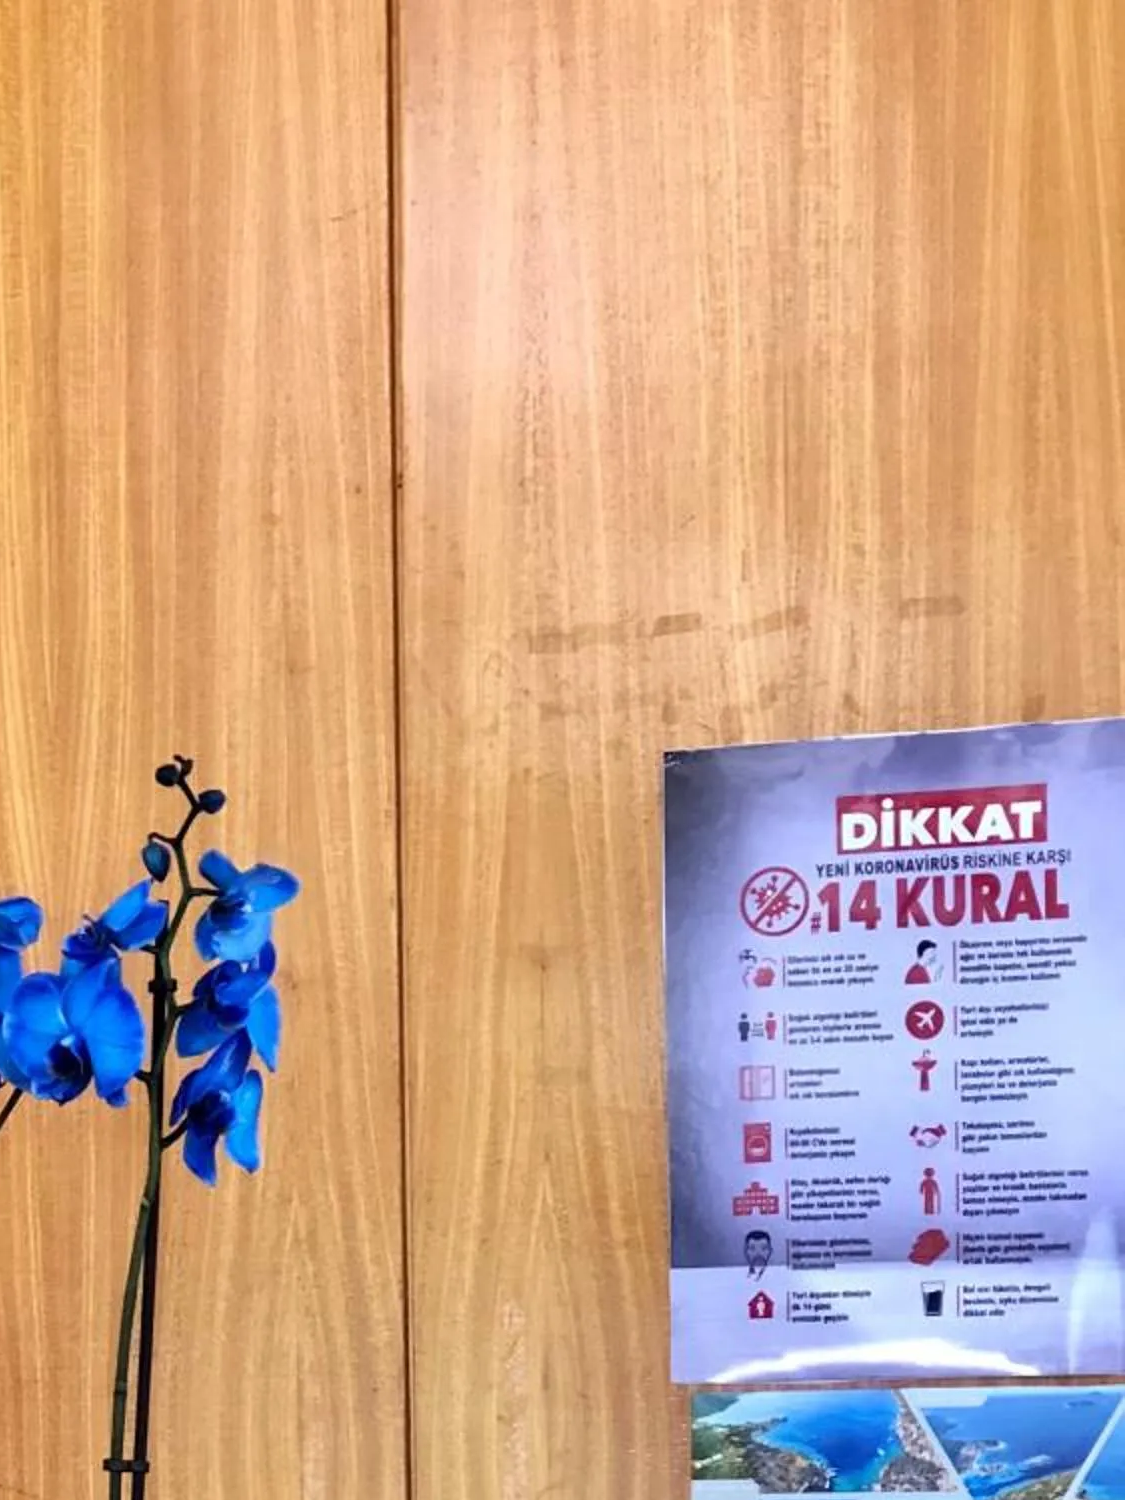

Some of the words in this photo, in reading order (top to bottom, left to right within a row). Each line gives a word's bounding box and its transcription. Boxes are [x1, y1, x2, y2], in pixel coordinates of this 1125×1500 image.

[840, 797, 1043, 851] DİKKAT
[816, 860, 850, 878] YENİ
[855, 855, 960, 875] KORONAVİRÜS
[963, 851, 1021, 869] RİSKİNE
[1026, 848, 1071, 865] KARŞI
[896, 868, 1070, 929] KURAL
